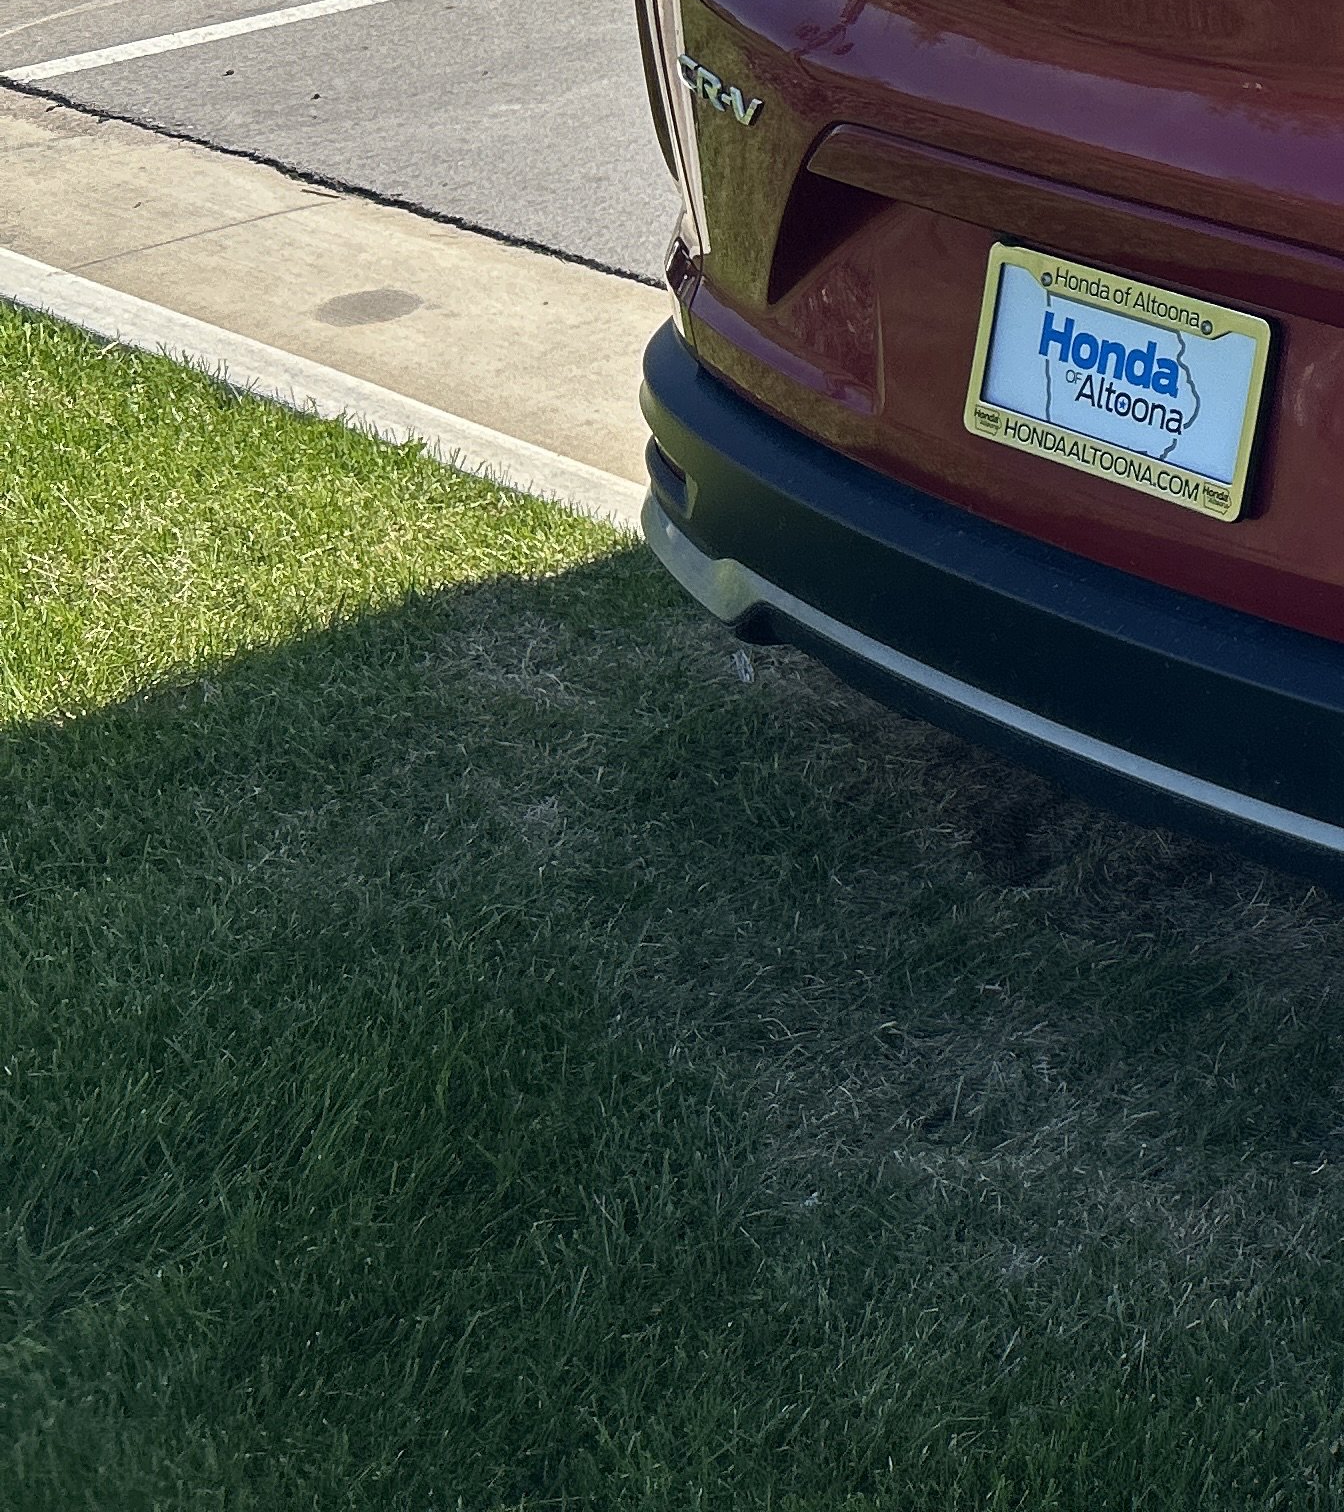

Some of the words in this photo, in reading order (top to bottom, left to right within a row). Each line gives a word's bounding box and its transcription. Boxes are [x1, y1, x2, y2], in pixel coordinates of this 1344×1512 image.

[677, 53, 763, 126] CR-V
[1054, 266, 1110, 301] Honda
[1113, 287, 1133, 307] of
[1132, 291, 1200, 329] Altoona
[1038, 310, 1179, 399] Honda
[1065, 369, 1083, 386] OF
[1074, 374, 1184, 436] Altoona
[1003, 417, 1200, 502] HONDAALTOONA.COM
